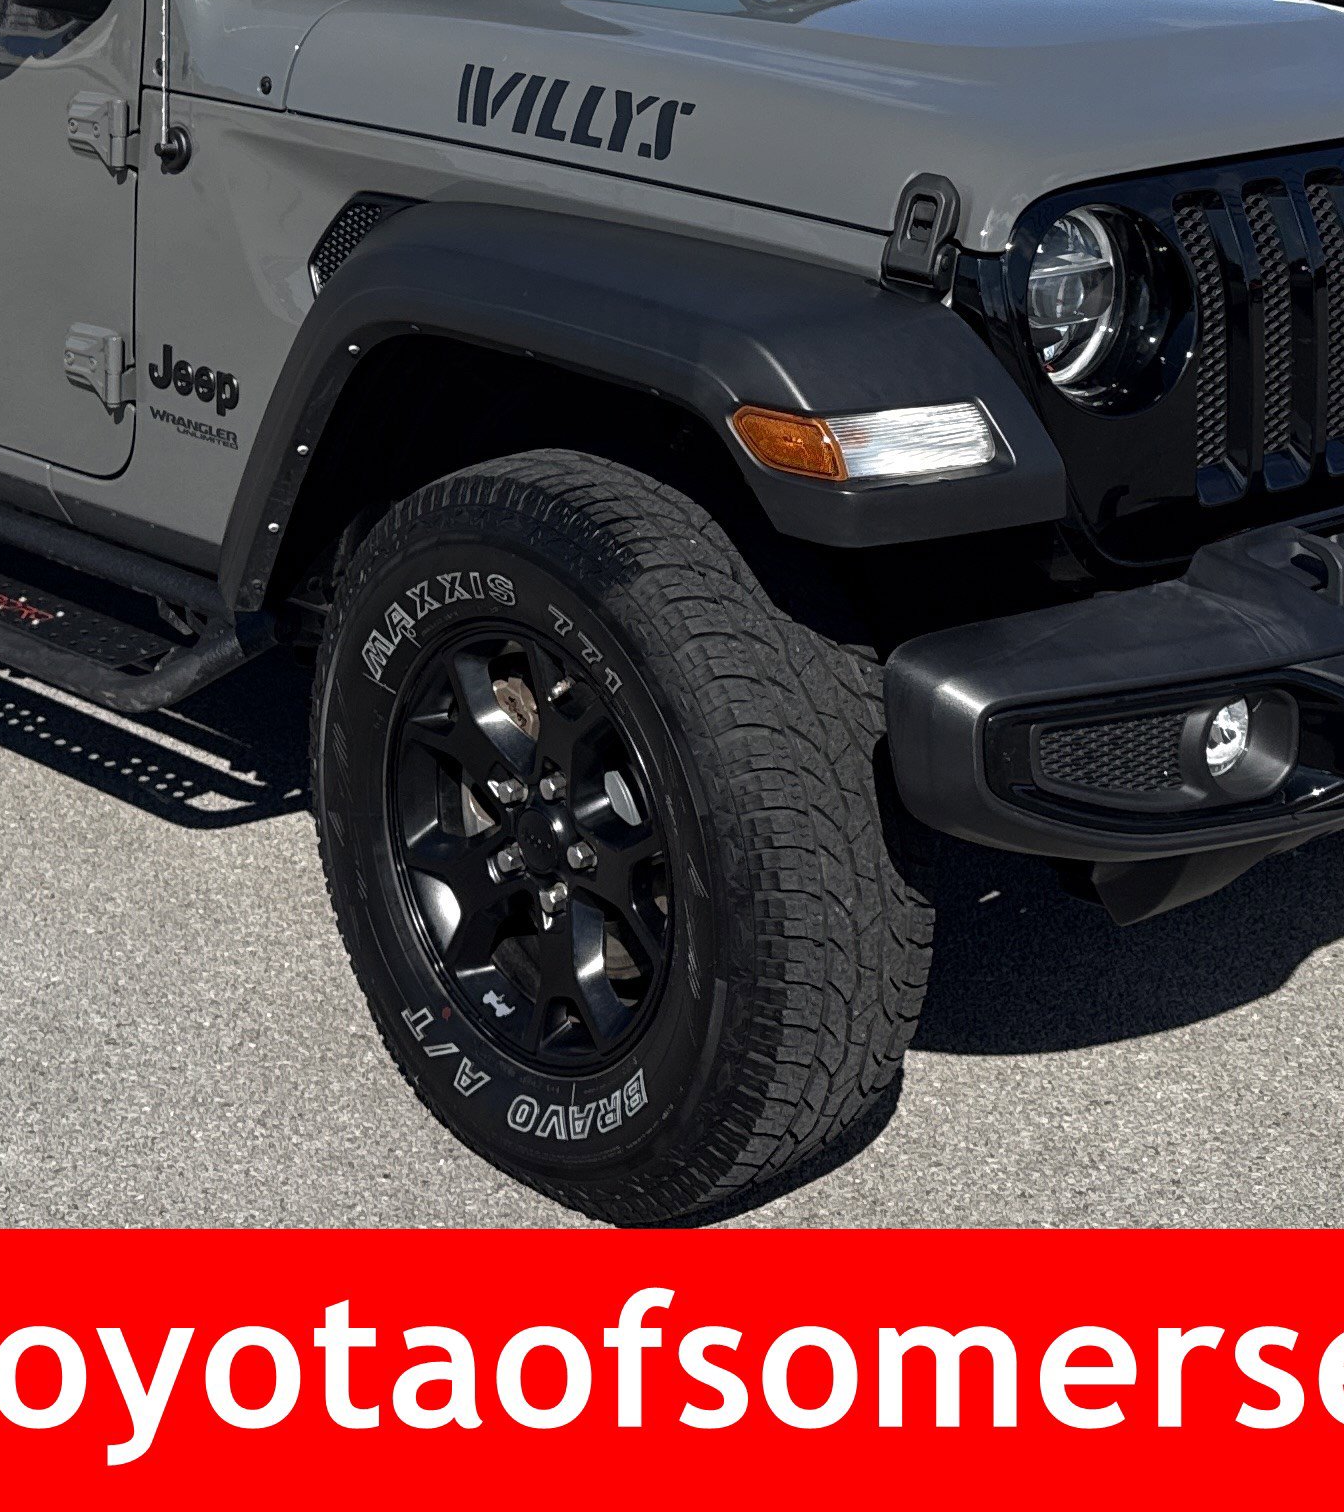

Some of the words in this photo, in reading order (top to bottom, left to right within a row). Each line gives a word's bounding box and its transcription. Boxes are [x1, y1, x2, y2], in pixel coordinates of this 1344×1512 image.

[457, 63, 696, 160] WILLYS
[149, 343, 239, 417] Jeep
[150, 405, 237, 445] WRANGLER
[176, 426, 238, 450] UNLIMITED
[361, 571, 517, 681] MAXXIS
[401, 1007, 492, 1098] A/T
[507, 1068, 648, 1141] BRAVO
